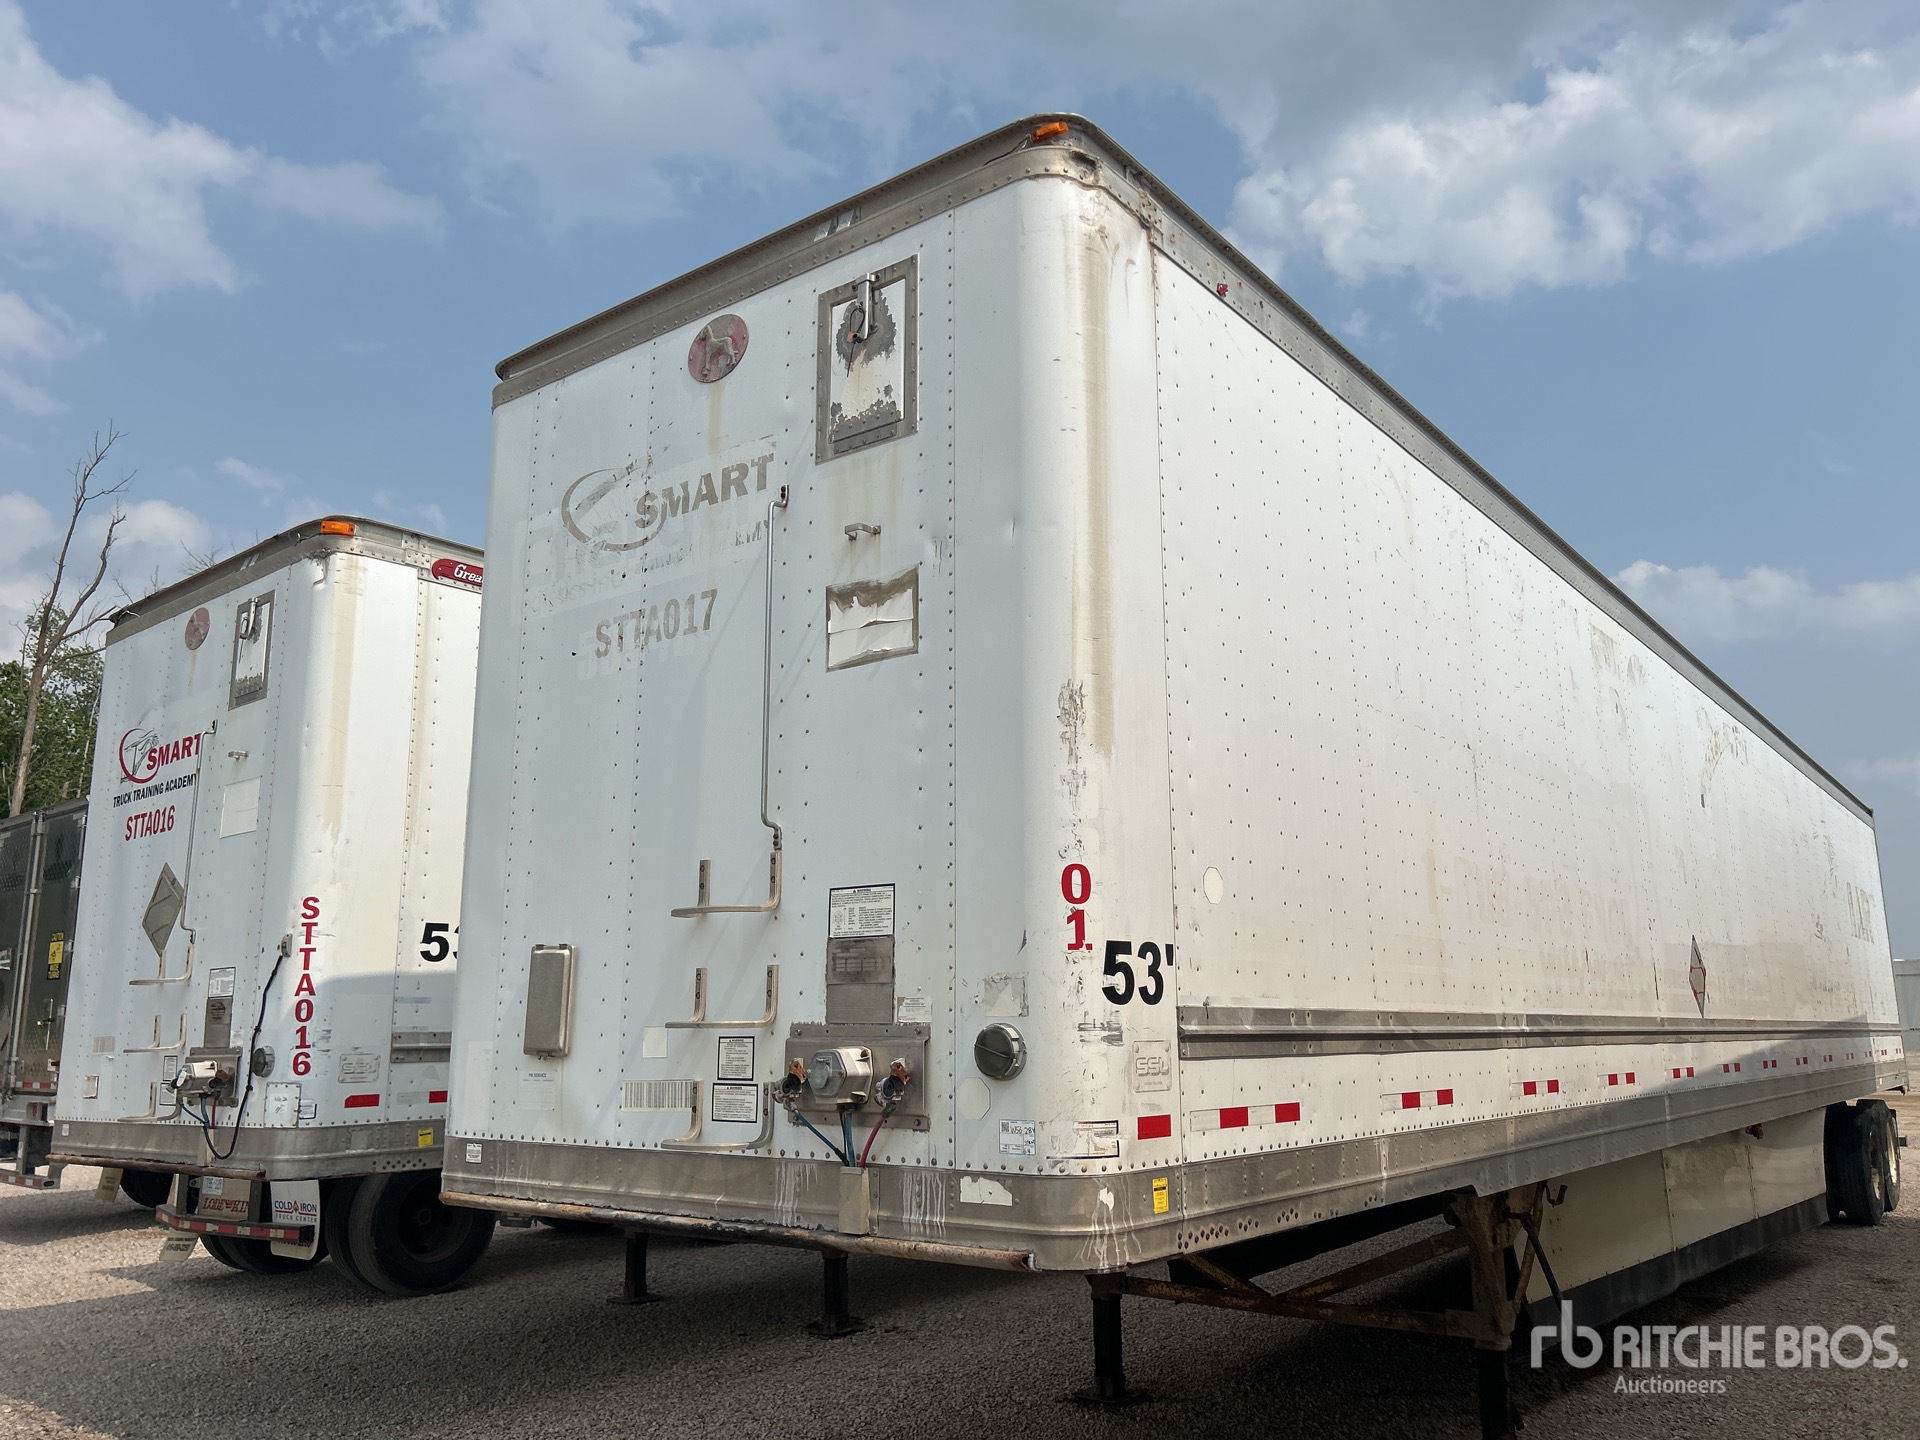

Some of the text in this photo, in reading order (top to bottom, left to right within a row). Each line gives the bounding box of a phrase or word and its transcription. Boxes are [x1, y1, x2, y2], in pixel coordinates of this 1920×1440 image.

[634, 453, 775, 529] SMART
[594, 588, 718, 659] STTA017
[146, 733, 201, 771] SMART
[113, 773, 199, 808] TRUCK TRAINING ACADEMY
[125, 805, 176, 841] STTA016
[1102, 940, 1174, 1006] 53'
[274, 1200, 318, 1213] COLD IRON
[275, 1213, 318, 1223] TRUCK CENTER
